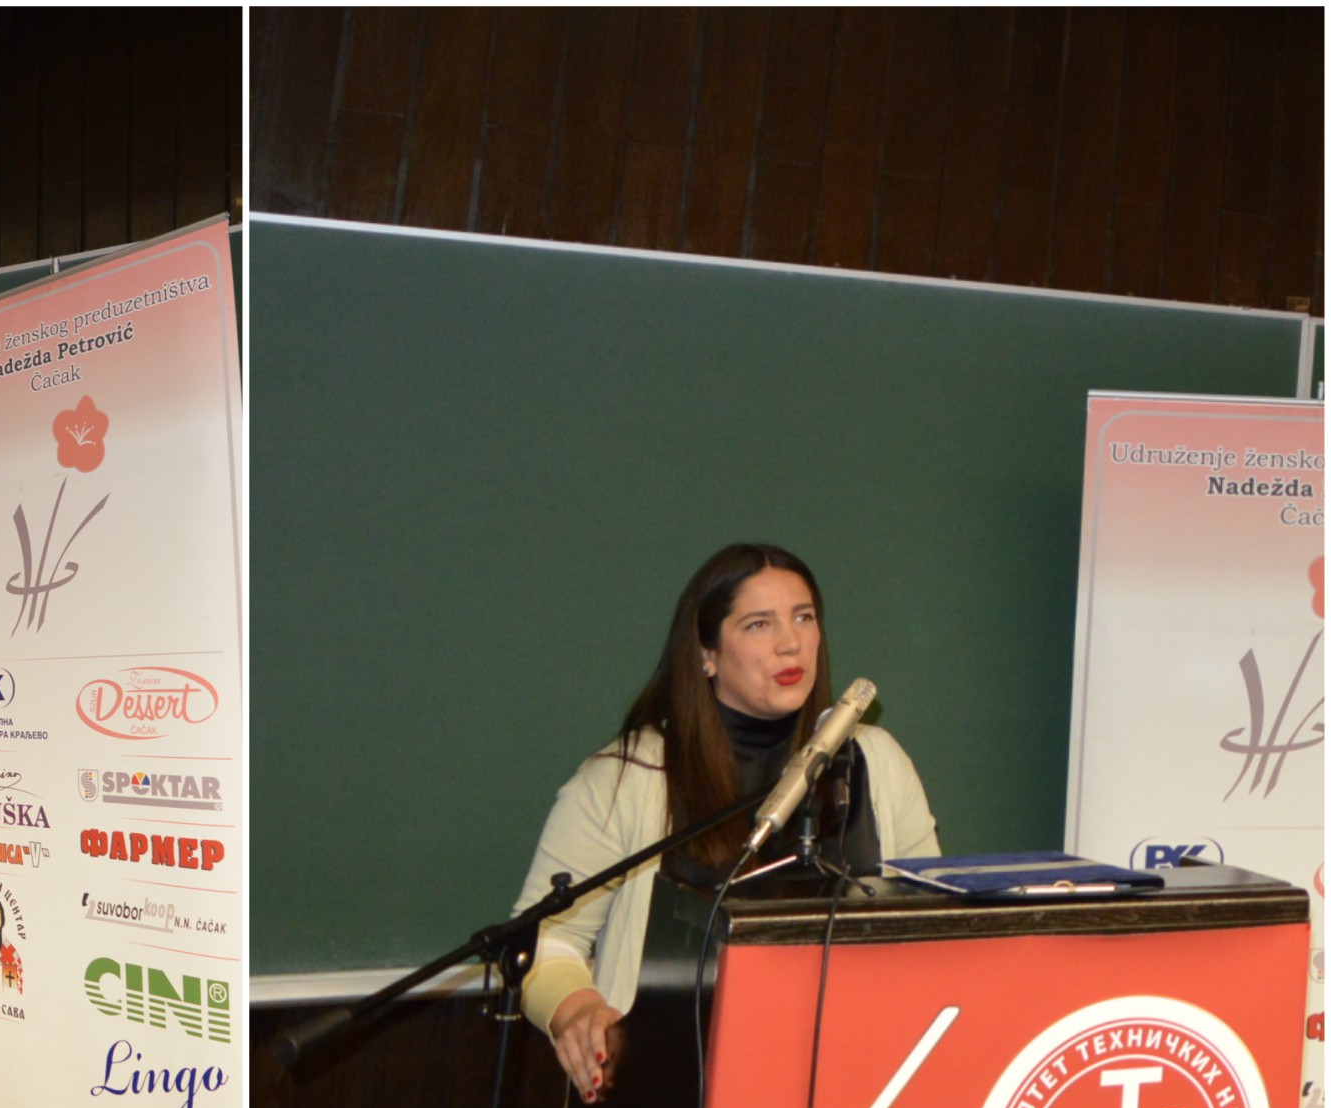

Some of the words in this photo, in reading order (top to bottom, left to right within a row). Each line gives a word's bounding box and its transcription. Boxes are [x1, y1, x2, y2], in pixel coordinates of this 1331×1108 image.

[4, 320, 69, 350] ženskog
[73, 274, 212, 334] preduzetništva
[57, 322, 134, 360] Petrović
[30, 365, 82, 392] Čačak
[1110, 442, 1237, 471] Udruženje
[1206, 476, 1314, 498] Nadežda
[87, 679, 203, 724] Dessert
[10, 730, 49, 740] КРАЉЕВО
[130, 724, 158, 735] ČAČAK
[80, 828, 226, 872] ФАРМЕР
[195, 917, 228, 935] ČAČAK
[1075, 1028, 1224, 1086] ТЕХНИЧКИХ
